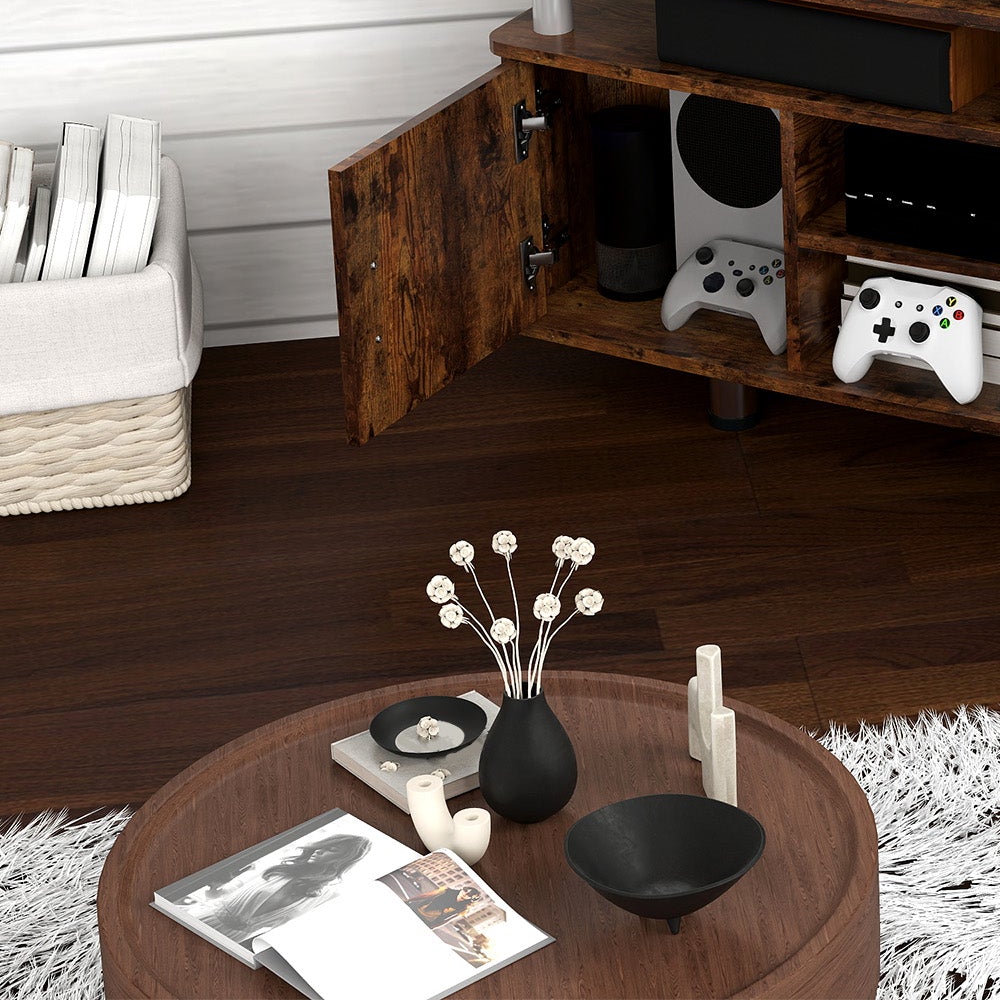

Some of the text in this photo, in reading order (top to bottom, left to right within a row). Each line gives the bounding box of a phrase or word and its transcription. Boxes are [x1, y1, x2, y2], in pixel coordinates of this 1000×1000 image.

[949, 297, 956, 306] Y
[933, 306, 942, 315] X
[955, 310, 963, 319] B
[940, 318, 948, 328] A
